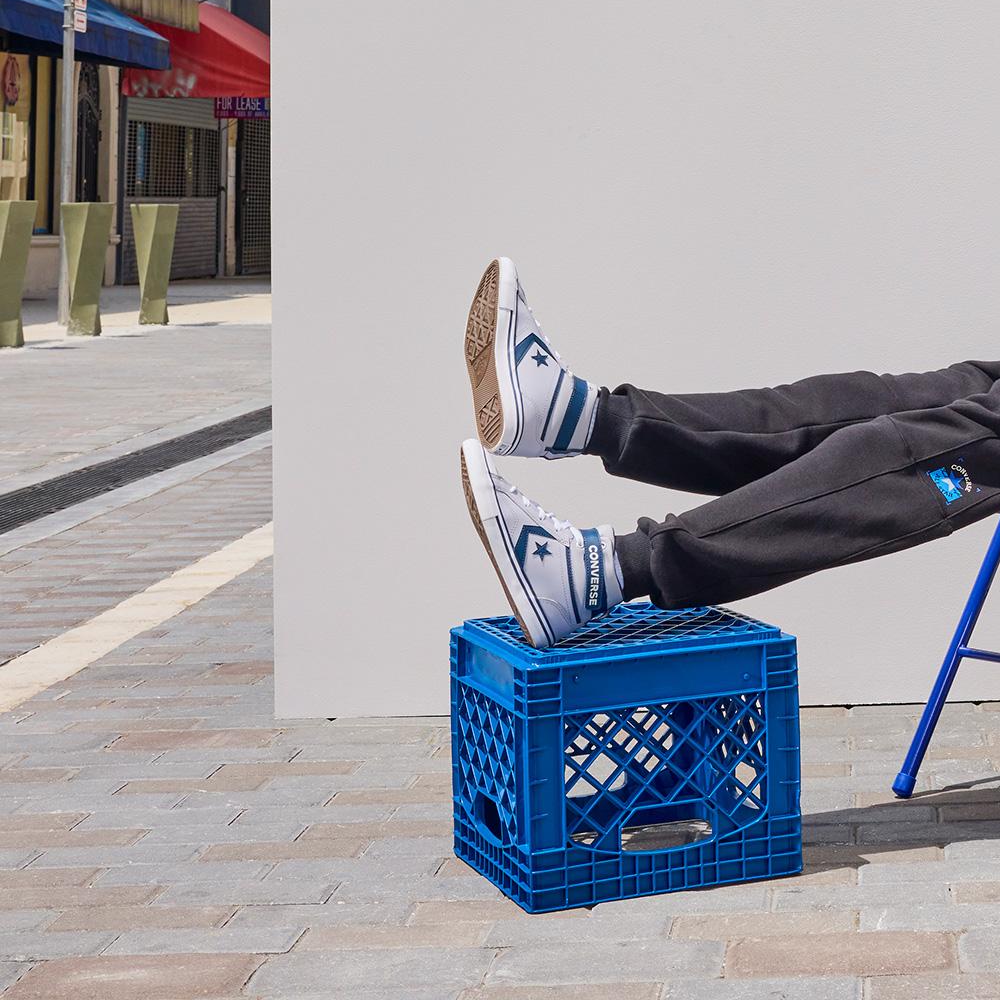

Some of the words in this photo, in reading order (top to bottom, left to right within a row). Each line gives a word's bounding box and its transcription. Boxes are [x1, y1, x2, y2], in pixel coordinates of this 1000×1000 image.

[216, 97, 233, 110] FOR
[236, 97, 261, 111] LEASE
[951, 464, 973, 493] CONVERSE
[588, 544, 600, 606] CONVERSE
